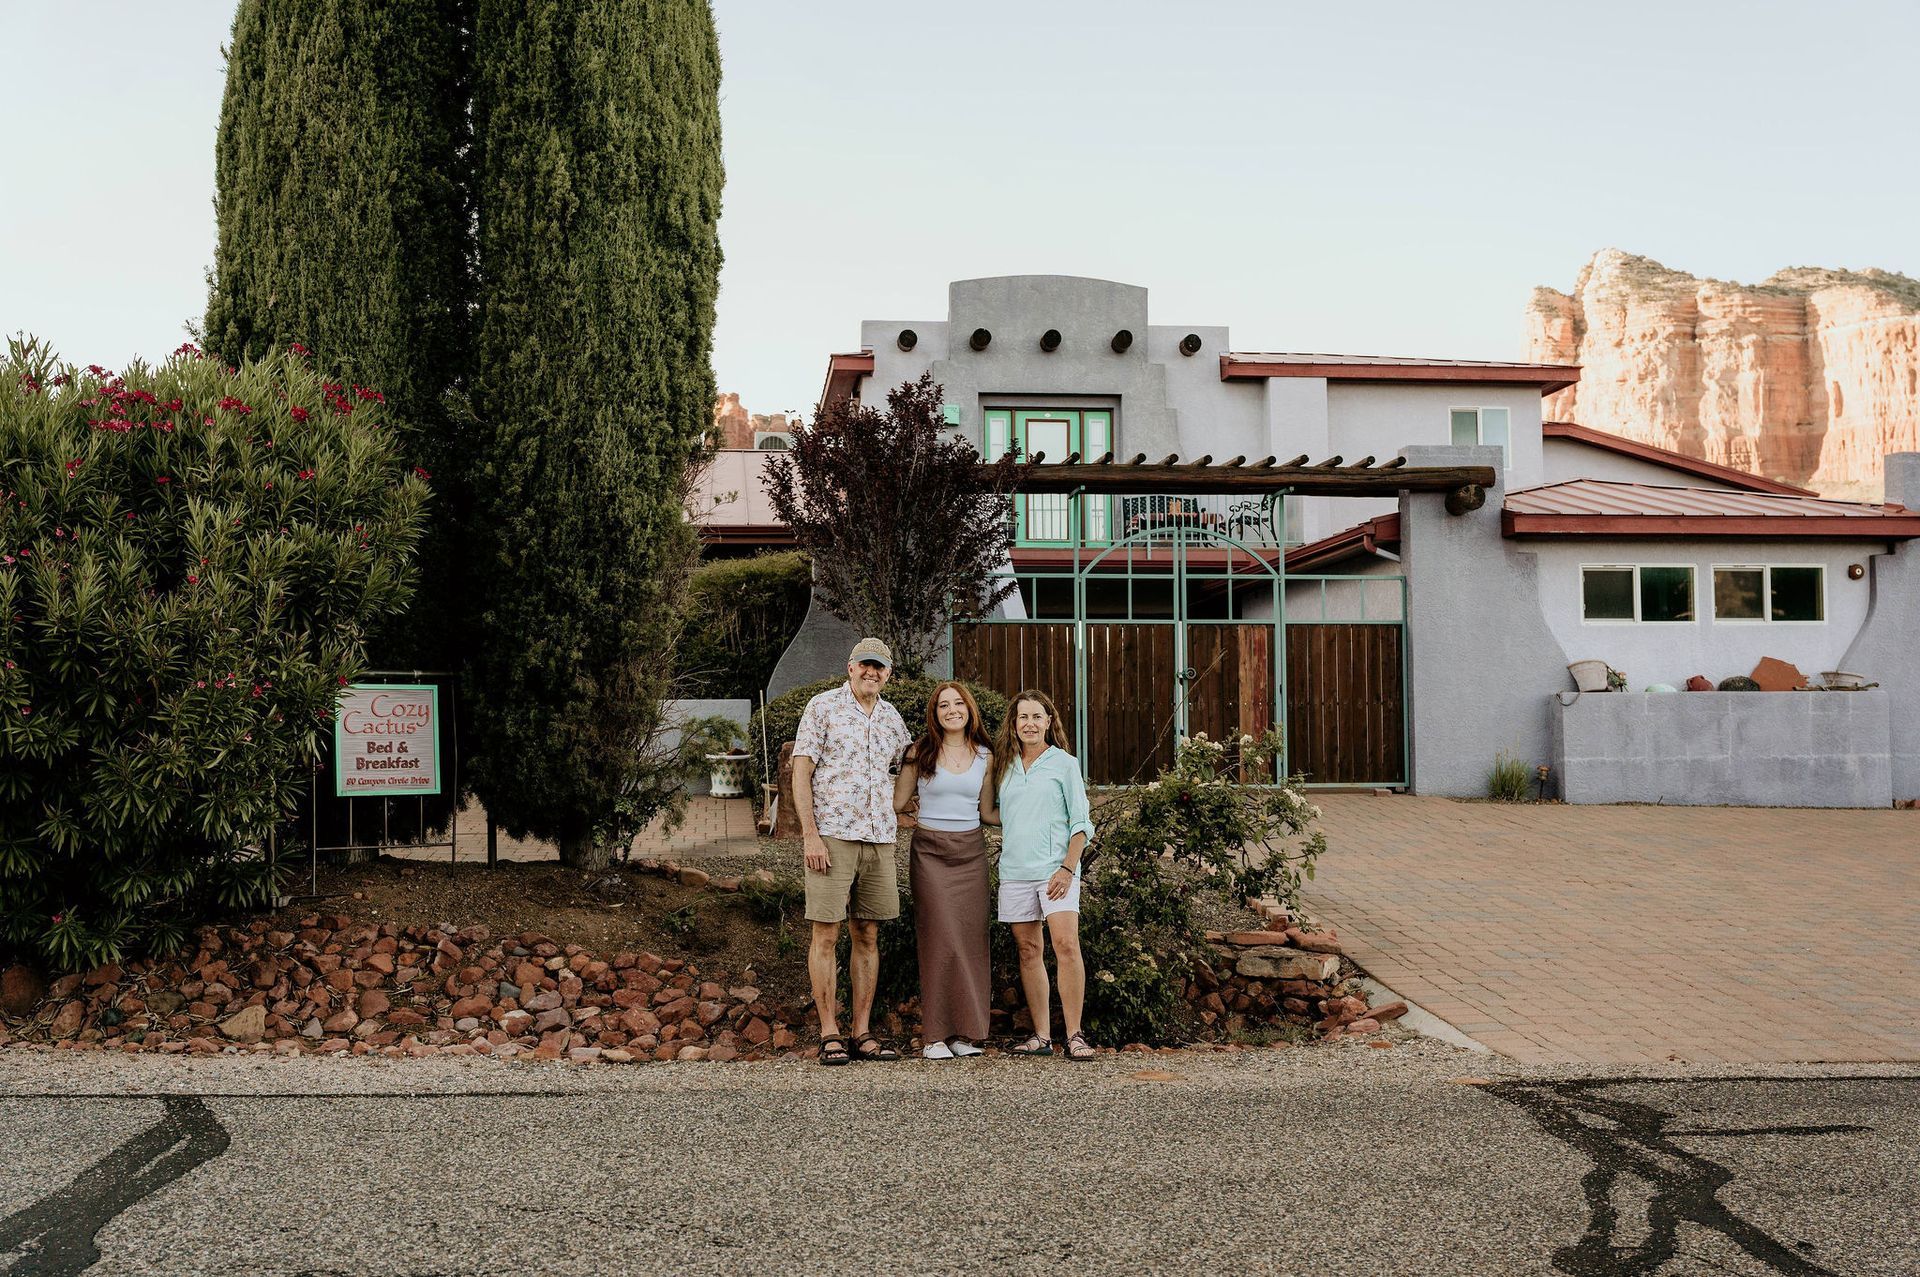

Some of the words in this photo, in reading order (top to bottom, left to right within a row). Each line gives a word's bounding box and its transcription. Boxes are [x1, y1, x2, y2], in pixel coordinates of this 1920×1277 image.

[371, 695, 430, 727] Cozy
[344, 710, 417, 734] Cactus
[367, 741, 393, 753] Bed
[397, 741, 408, 753] &
[356, 757, 420, 769] Breakfast
[358, 777, 385, 786] Canyon
[388, 776, 409, 784] Circle
[411, 776, 430, 784] Drive
